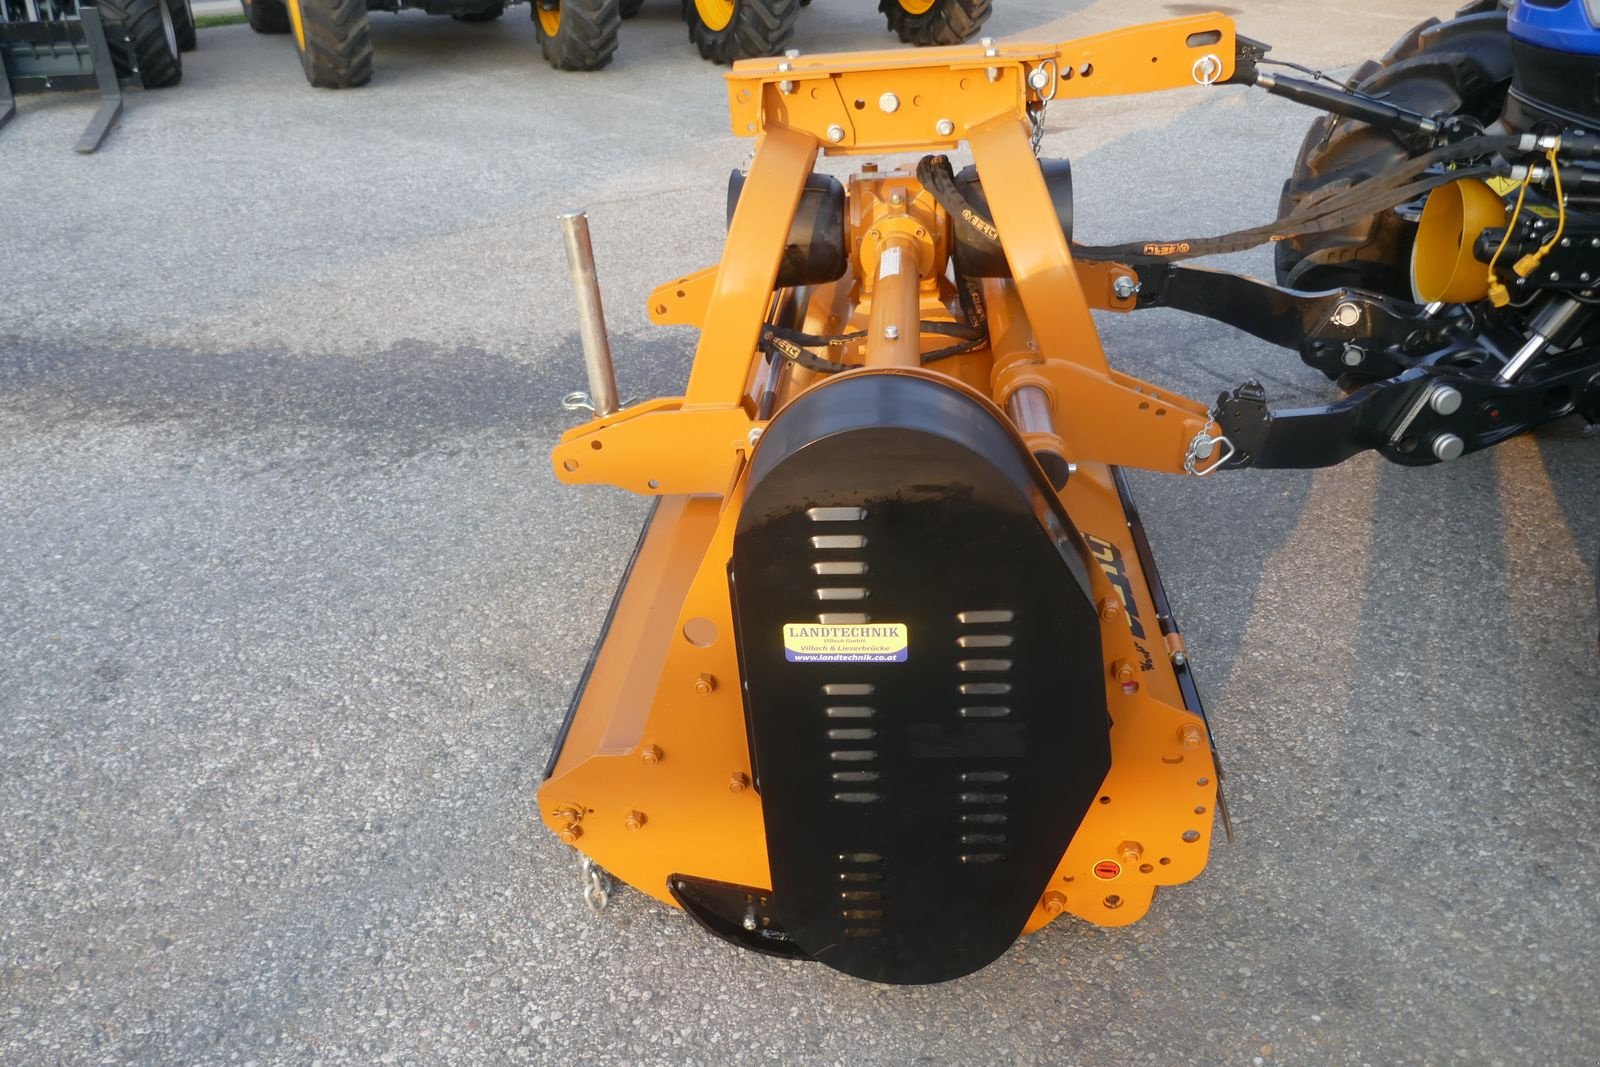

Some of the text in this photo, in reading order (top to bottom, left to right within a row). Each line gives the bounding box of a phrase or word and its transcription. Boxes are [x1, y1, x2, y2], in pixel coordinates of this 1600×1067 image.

[789, 627, 900, 638] LANDTECHNIK
[837, 644, 890, 652] Lieserbrücke
[794, 653, 897, 662] www.landtechnik.co.at
